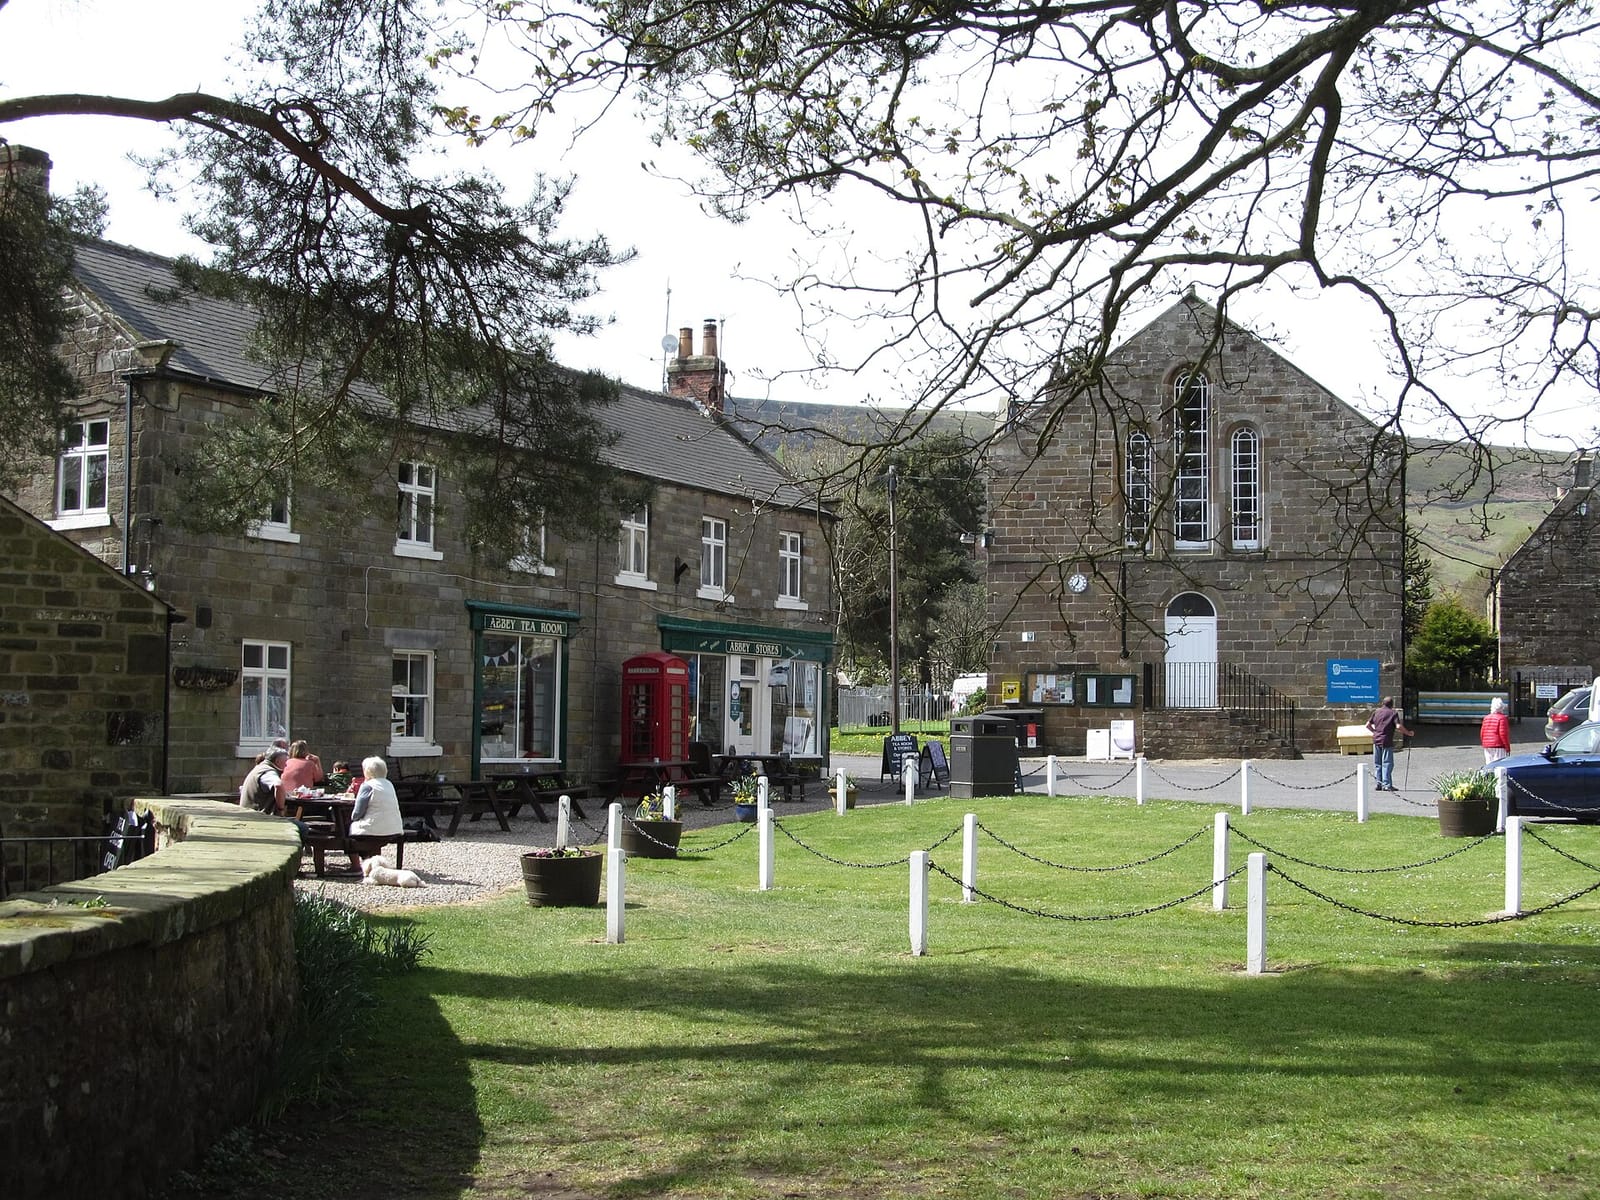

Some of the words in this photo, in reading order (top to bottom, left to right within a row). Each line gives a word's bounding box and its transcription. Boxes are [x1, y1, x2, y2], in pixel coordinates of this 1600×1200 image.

[490, 617, 516, 630] ABBEY
[520, 620, 536, 632] TEA
[540, 622, 563, 634] ROOM
[729, 642, 750, 653] ABBEY
[755, 644, 779, 655] STORES
